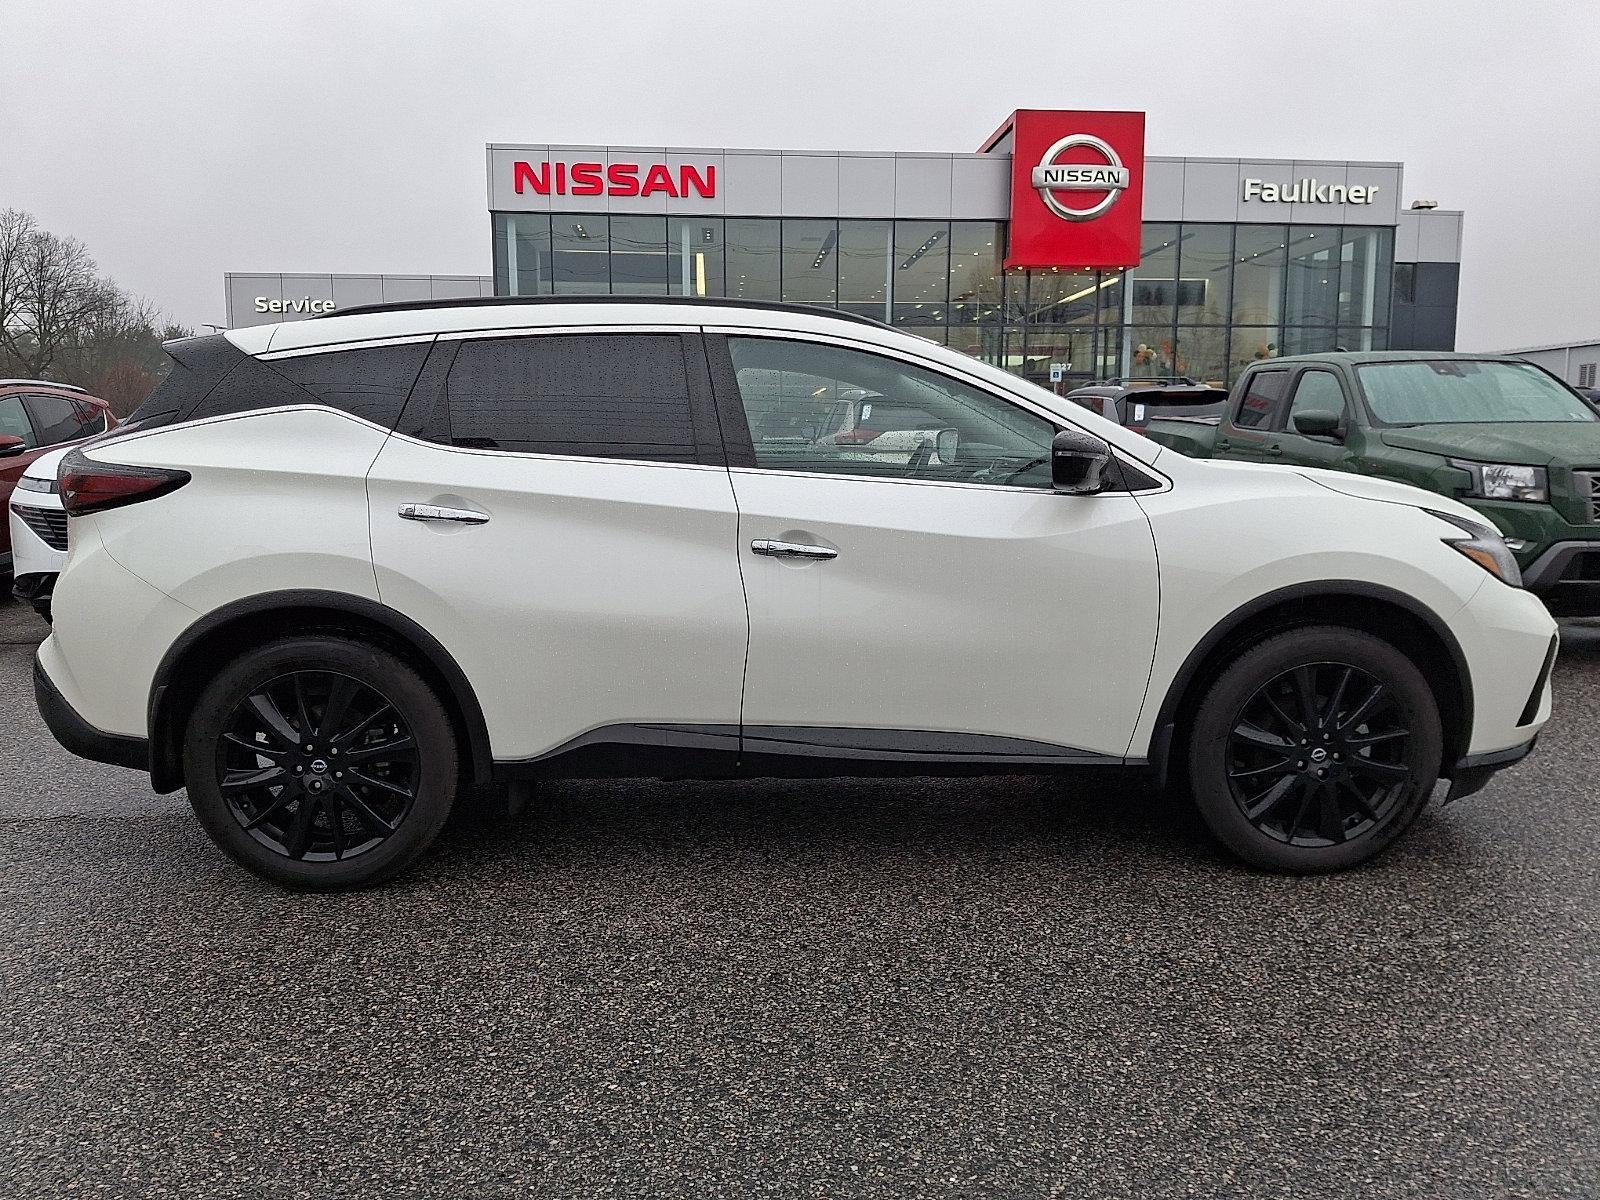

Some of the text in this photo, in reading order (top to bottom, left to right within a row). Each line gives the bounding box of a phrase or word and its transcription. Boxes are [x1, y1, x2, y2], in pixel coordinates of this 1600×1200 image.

[514, 162, 715, 198] NISSAN
[1044, 169, 1120, 183] NISSAN
[1243, 178, 1379, 204] Faulkner
[254, 296, 336, 313] Service
